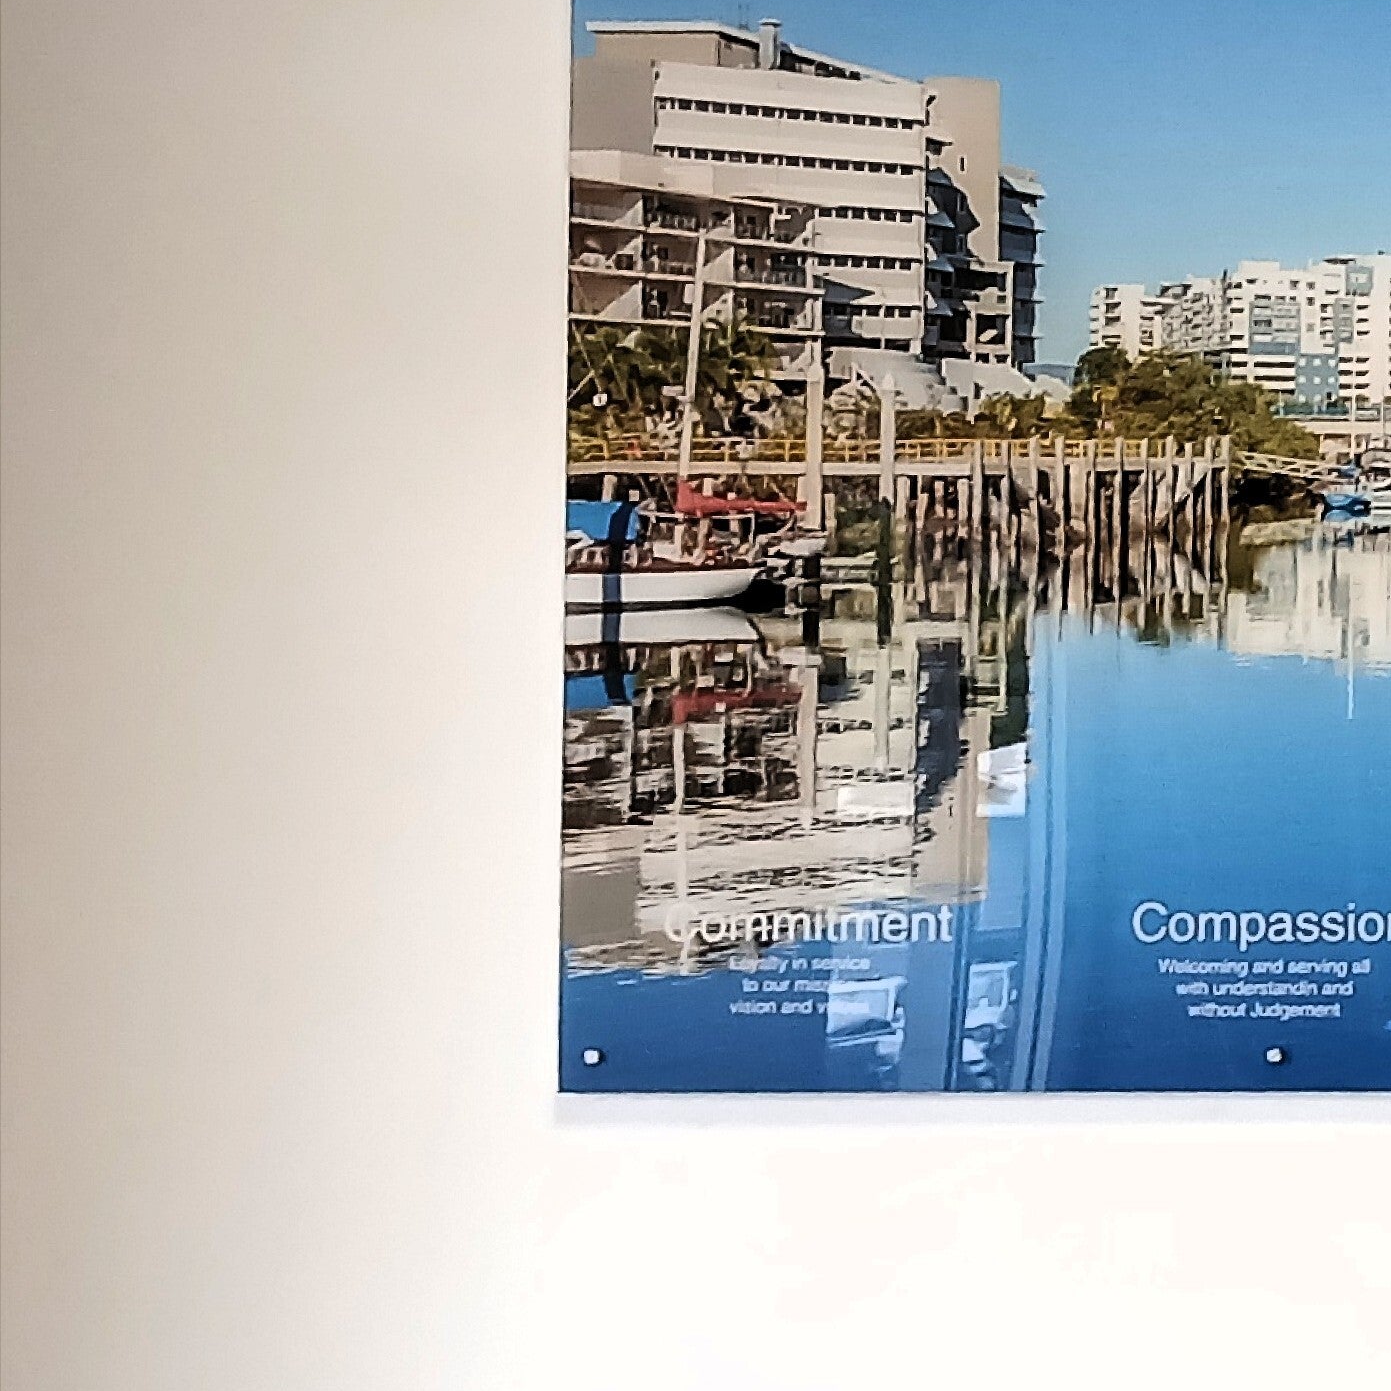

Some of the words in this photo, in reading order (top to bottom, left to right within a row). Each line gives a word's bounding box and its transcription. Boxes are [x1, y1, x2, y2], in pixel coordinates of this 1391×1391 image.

[665, 902, 953, 943] Commitment
[791, 956, 807, 970] in
[811, 955, 871, 970] service
[1158, 958, 1249, 977] Welcoming
[1252, 958, 1284, 974] and
[1287, 958, 1348, 978] serving
[1352, 958, 1372, 974] all
[742, 978, 759, 992] to
[762, 980, 791, 992] our
[1176, 980, 1209, 996] with
[1213, 980, 1318, 996] understandin
[1321, 980, 1354, 996] and
[728, 998, 776, 1014] vision
[780, 998, 814, 1014] and
[1187, 1001, 1246, 1017] without
